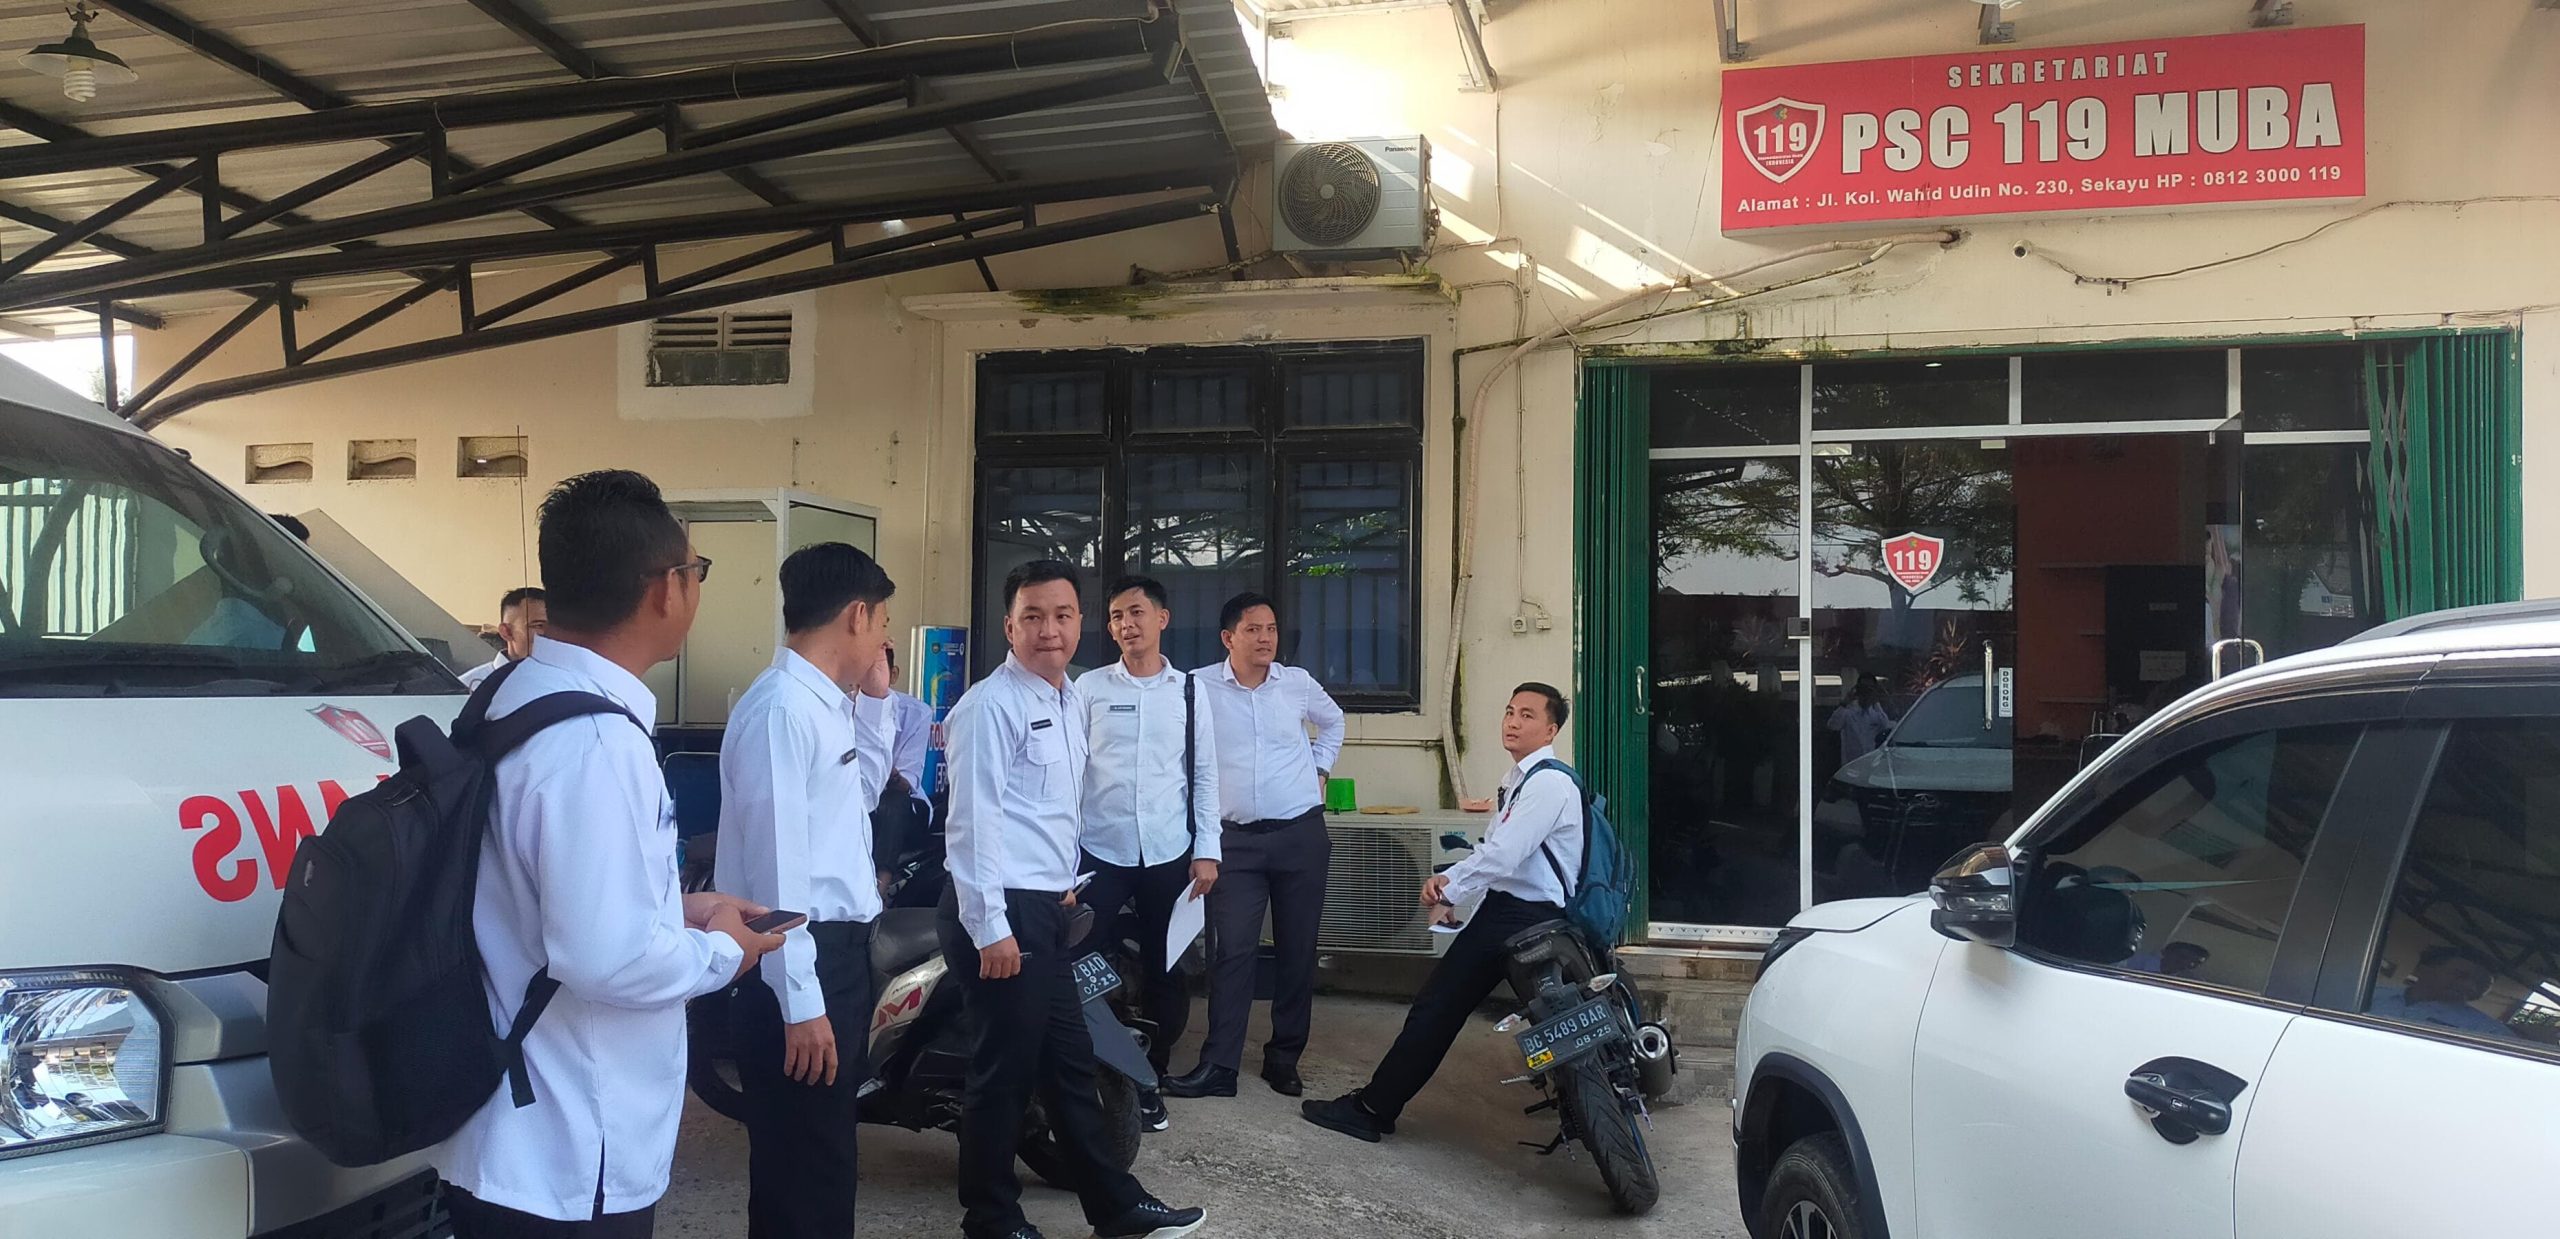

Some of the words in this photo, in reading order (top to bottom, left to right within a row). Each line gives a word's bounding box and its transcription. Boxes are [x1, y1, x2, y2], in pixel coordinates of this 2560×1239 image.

[1948, 52, 2168, 88] SEKRETARIAT
[1753, 122, 1807, 154] 119
[1842, 105, 1970, 174] PSC
[1993, 97, 2107, 164] 119
[2134, 82, 2342, 157] MUBA
[1738, 197, 1799, 213] Alamat
[1817, 193, 1838, 207] Jl.
[1845, 191, 1880, 206] Kol.
[1887, 186, 1943, 203] Wahid
[1950, 185, 1991, 200] Udin
[1998, 182, 2029, 197] No.
[2035, 180, 2074, 195] 230,
[2081, 177, 2149, 193] Sekayu
[2157, 173, 2183, 188] HP
[2203, 170, 2248, 186] 0812
[2255, 167, 2301, 183] 3000
[2308, 165, 2342, 181] 119
[1893, 549, 1932, 570] 119
[2002, 670, 2010, 708] DORONG
[1078, 955, 1106, 978] BAD
[1543, 1017, 1577, 1043] 5489
[1578, 1005, 1606, 1028] BAR
